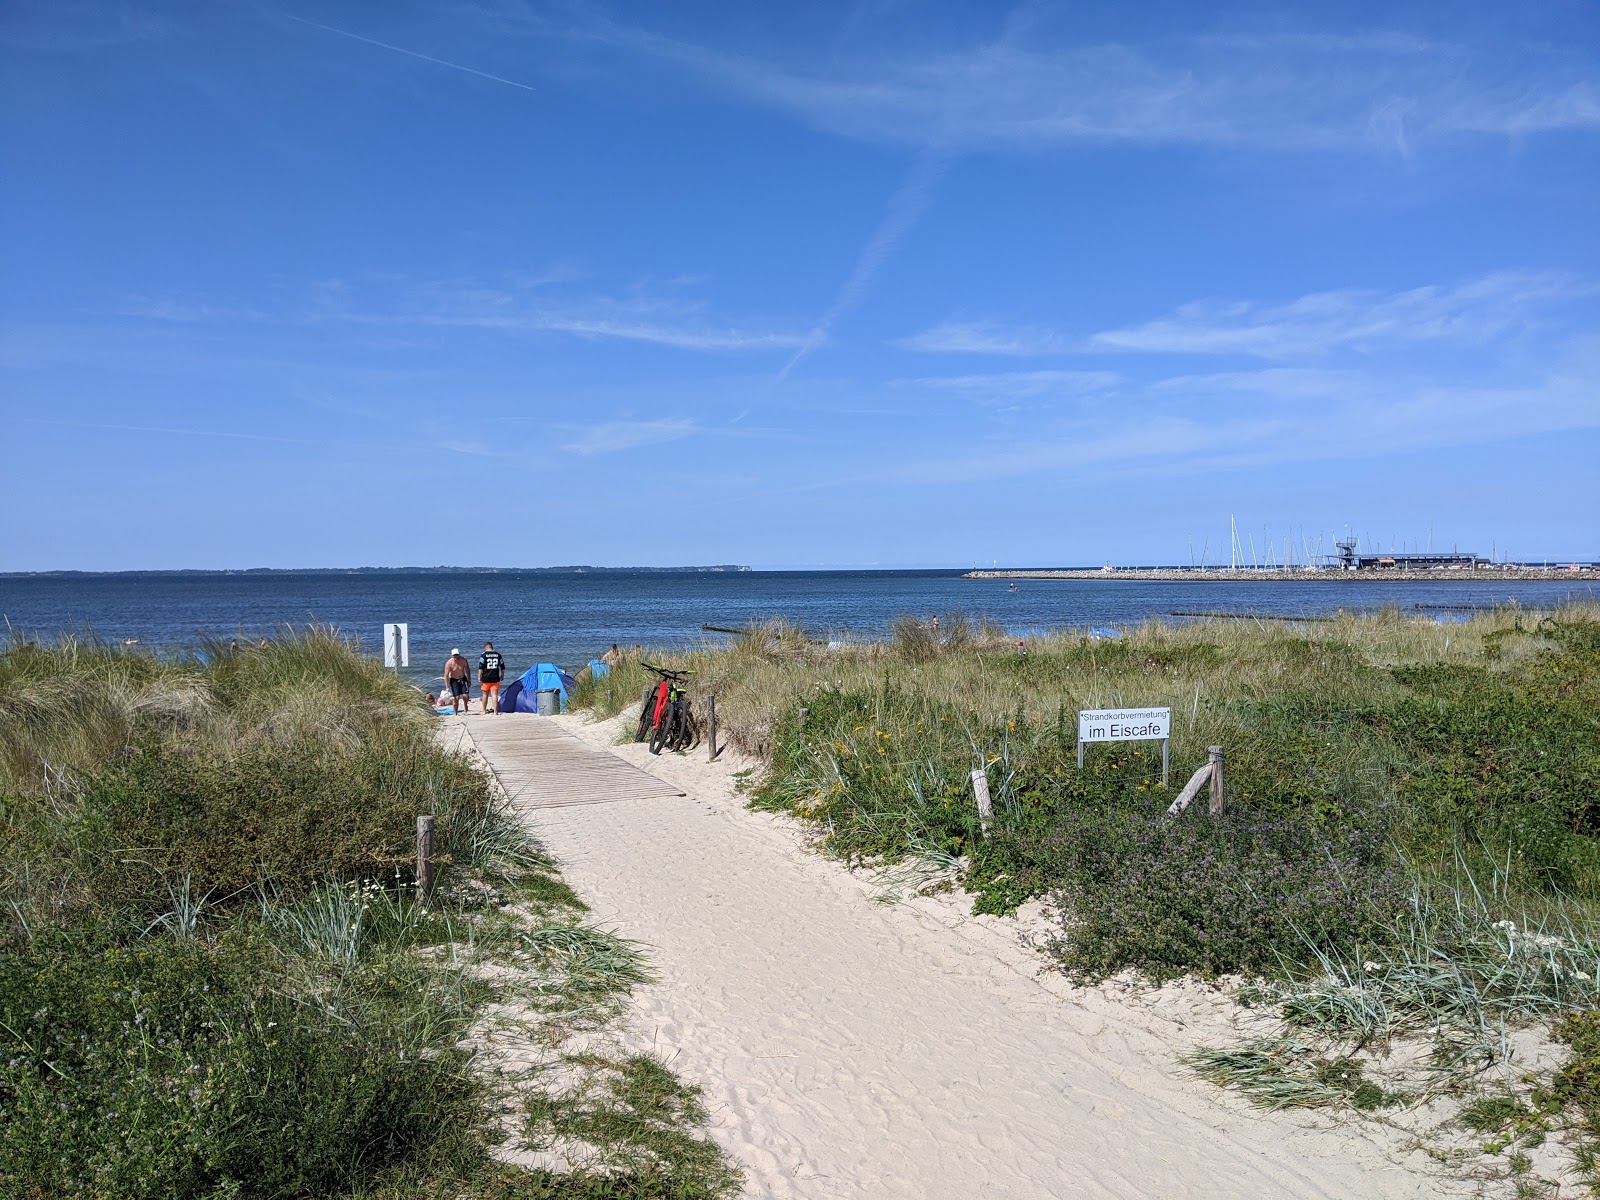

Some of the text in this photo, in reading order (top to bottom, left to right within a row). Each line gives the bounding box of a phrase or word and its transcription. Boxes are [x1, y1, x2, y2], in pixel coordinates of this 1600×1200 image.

[486, 658, 499, 670] 22
[1083, 711, 1167, 721] Strandkorbvermietung
[1089, 723, 1161, 738] im Eiscafe
